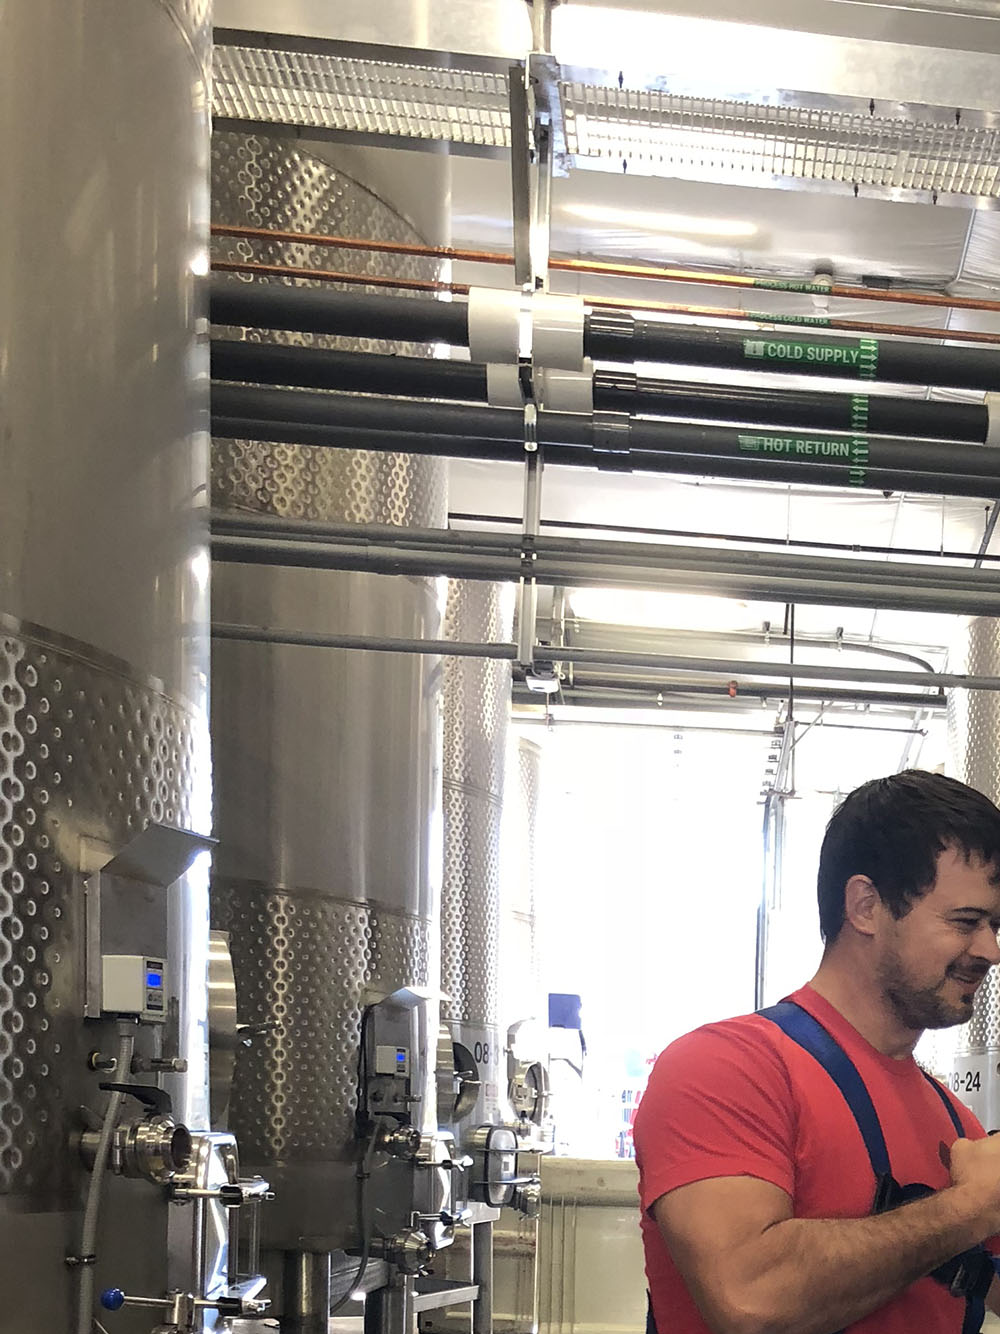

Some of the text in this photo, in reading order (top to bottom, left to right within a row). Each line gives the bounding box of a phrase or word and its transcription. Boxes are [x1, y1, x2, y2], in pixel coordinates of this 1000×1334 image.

[805, 284, 830, 292] WATER
[767, 343, 859, 363] COLD SUPPLY
[763, 437, 849, 456] HOT RETURN
